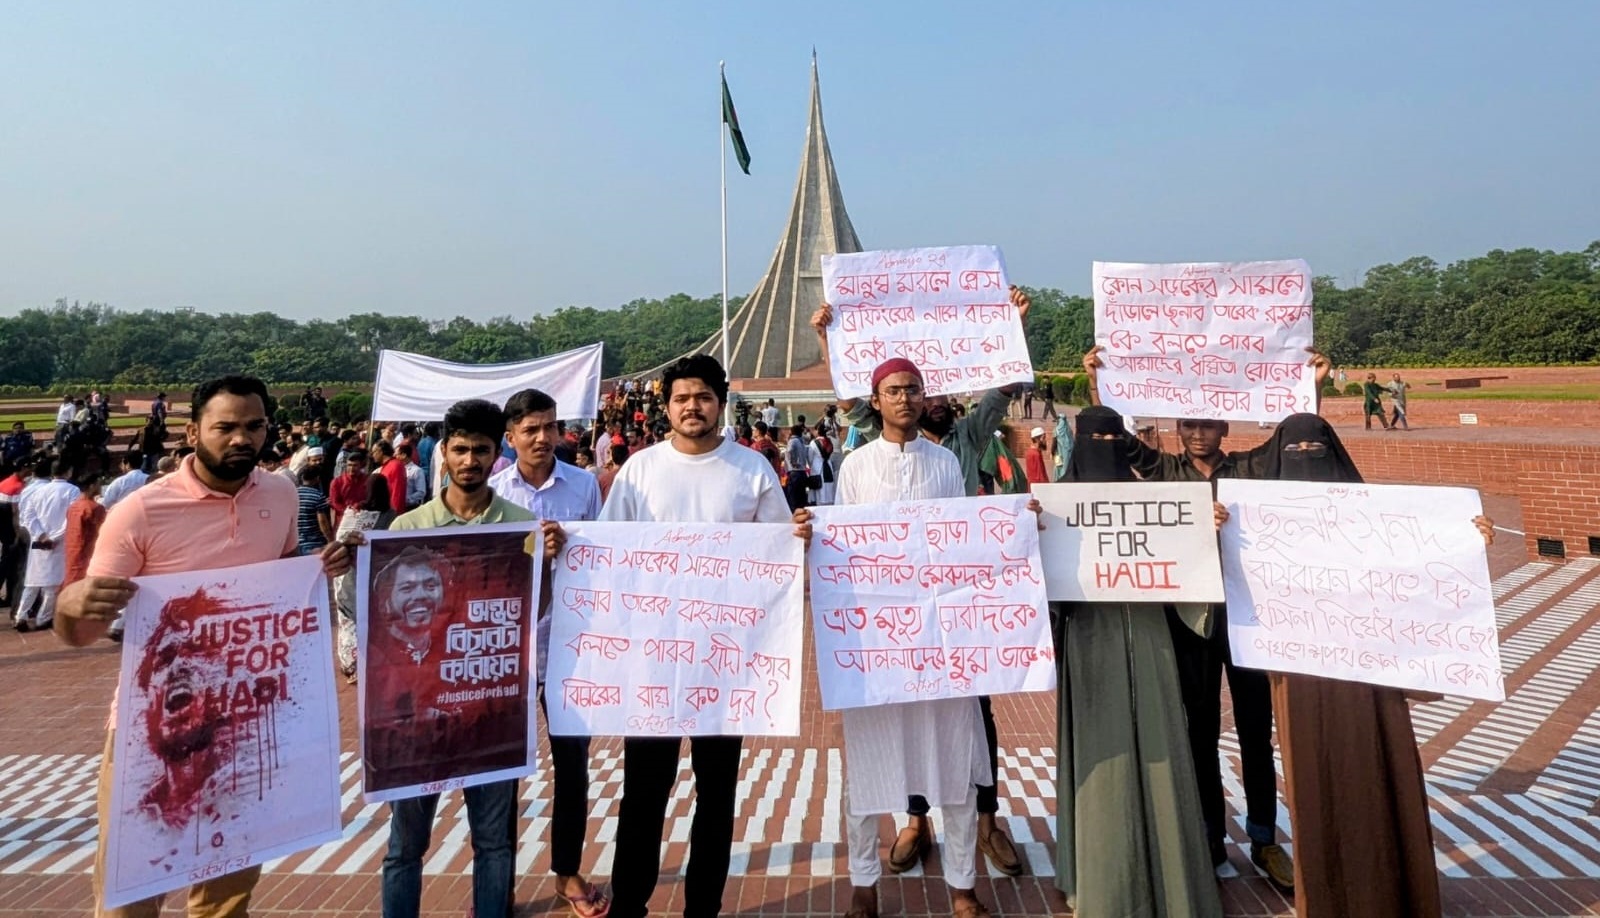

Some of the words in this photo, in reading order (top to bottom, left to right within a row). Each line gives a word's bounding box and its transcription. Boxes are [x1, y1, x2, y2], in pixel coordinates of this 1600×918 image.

[836, 273, 889, 299] মানুষ
[896, 271, 951, 293] মরলে
[959, 270, 1002, 291] প্রেস
[1102, 276, 1142, 296] কোন
[1147, 277, 1218, 298] সড়কের
[1229, 274, 1304, 296] সামনে
[1110, 330, 1141, 350] কে
[1149, 331, 1207, 355] বলতে
[1220, 334, 1265, 354] পারব
[1109, 356, 1185, 376] আমাদের
[1244, 362, 1304, 382] বোনের
[1200, 384, 1250, 412] বিচার
[1265, 386, 1297, 413] চাই
[822, 522, 910, 552] হাসনাত
[926, 520, 968, 552] ছাড়া
[979, 507, 1019, 544] কি
[1066, 501, 1194, 528] JUSTICE
[1098, 531, 1155, 557] FOR
[566, 544, 612, 571] কোন
[618, 548, 679, 575] সড়কের
[684, 553, 730, 578] সামনে
[817, 554, 914, 585] এনসিপিতে
[1001, 552, 1040, 586] নেই
[1095, 561, 1180, 589] HADI
[1425, 561, 1488, 609] কি
[621, 593, 672, 617] তারেক
[678, 599, 766, 628] রহমানকে
[824, 607, 867, 635] এত
[874, 606, 922, 644] মৃত্যু
[195, 607, 319, 648] JUSTICE
[446, 623, 521, 654] বিচারটা
[226, 642, 289, 678] FOR
[565, 633, 630, 660] বলতে
[644, 639, 695, 664] পারব
[834, 647, 946, 673] আপনাদের
[950, 647, 992, 681] ঘুম
[440, 652, 519, 685] করিয়েন
[204, 673, 288, 715] HADI
[437, 684, 519, 704] #JusticeForHadi
[562, 678, 620, 711] বিচারের
[637, 686, 669, 709] রায়
[685, 687, 719, 712] কত
